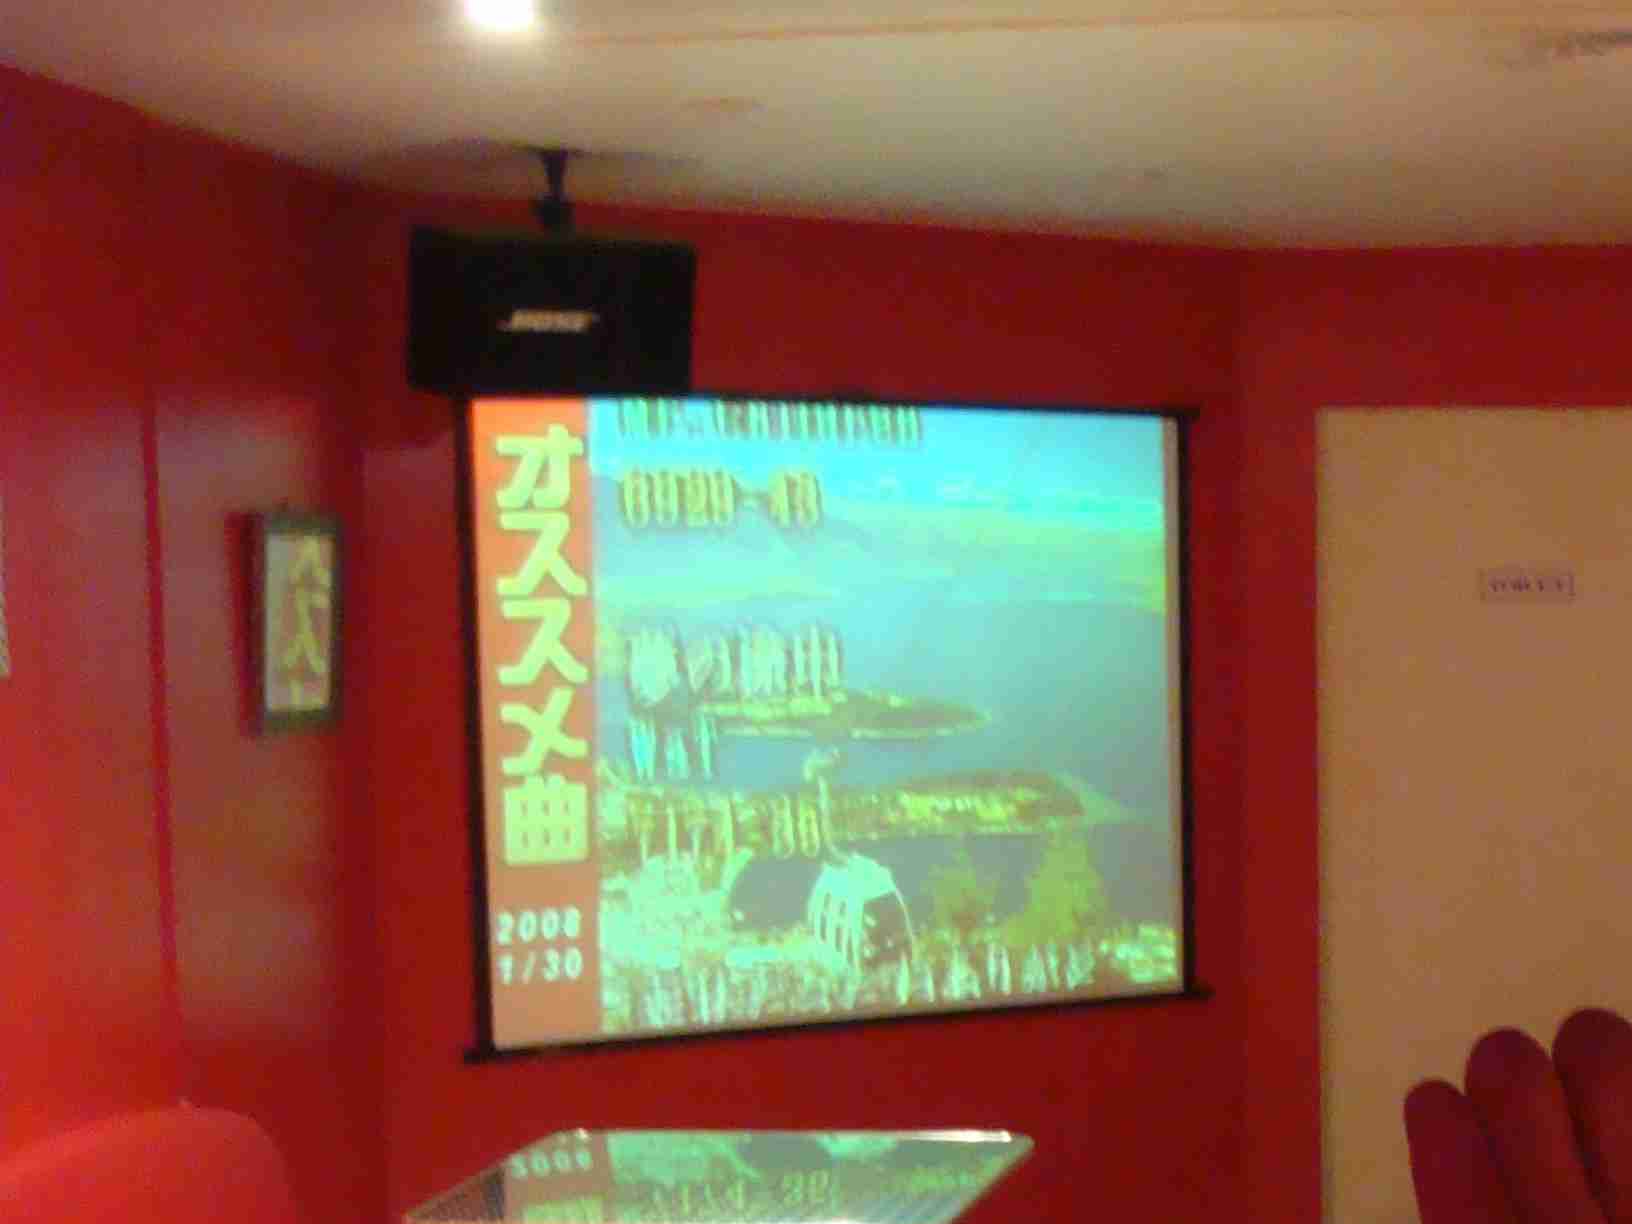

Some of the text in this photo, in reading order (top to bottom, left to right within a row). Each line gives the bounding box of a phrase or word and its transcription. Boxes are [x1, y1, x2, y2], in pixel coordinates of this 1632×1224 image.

[496, 424, 590, 866] オススメ曲
[496, 946, 583, 985] 1/30
